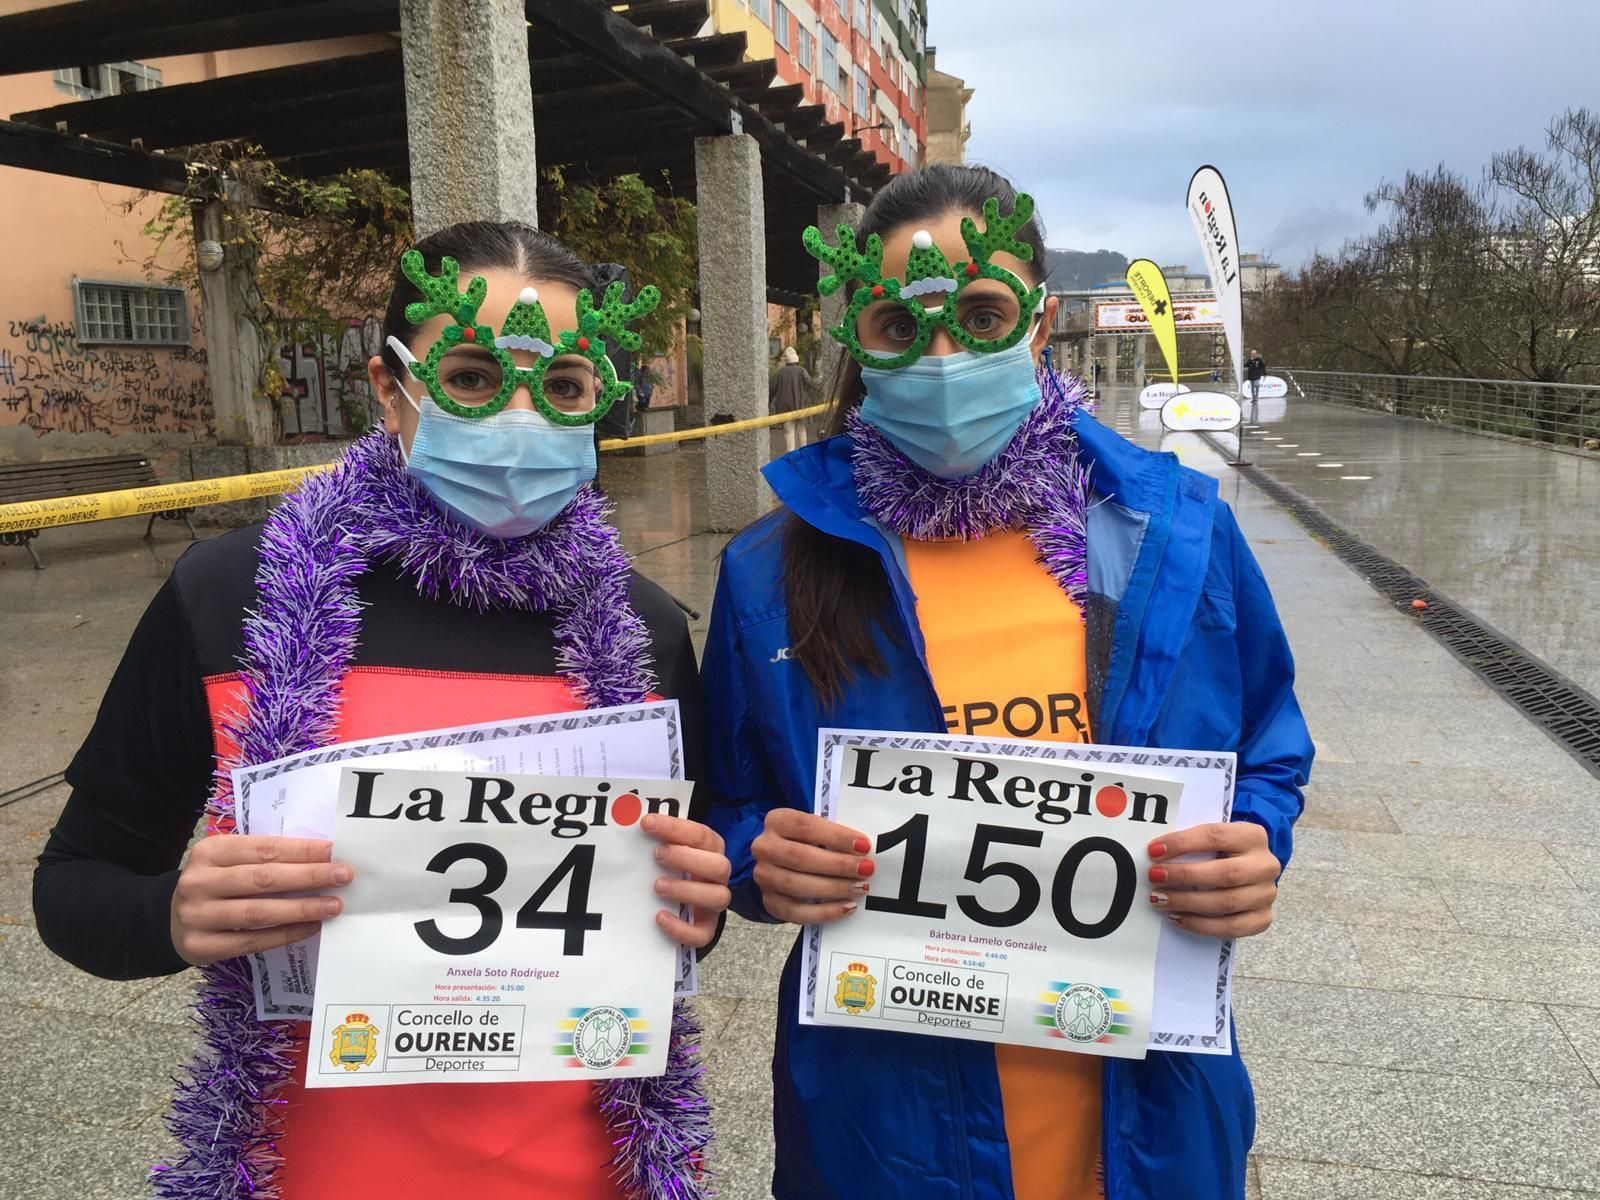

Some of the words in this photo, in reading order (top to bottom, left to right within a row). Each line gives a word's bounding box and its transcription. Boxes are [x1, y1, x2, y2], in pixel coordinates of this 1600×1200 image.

[137, 498, 176, 512] DEPORTES
[177, 497, 187, 506] DE
[188, 493, 221, 505] OURENSE
[43, 514, 57, 525] DE
[57, 509, 99, 523] OURENSE
[848, 748, 935, 797] La
[947, 757, 1169, 825] Región
[346, 771, 445, 822] La
[459, 776, 680, 839] Región
[864, 813, 1137, 939] 150
[414, 842, 603, 956] 34
[929, 929, 966, 942] Bárbara
[968, 934, 1003, 946] Lamelo
[1004, 939, 1048, 952] González
[924, 954, 940, 962] Hora
[940, 956, 960, 965] salida:
[963, 959, 985, 967] 4:54:40
[925, 944, 940, 952] Hora
[941, 946, 982, 957] presentación:
[985, 951, 1008, 960] 4:44:00
[447, 967, 482, 977] Anxela
[485, 967, 508, 978] Soto
[892, 965, 961, 987] Concello
[966, 974, 985, 990] de
[435, 984, 451, 992] Hora
[452, 984, 498, 993] presentación:
[500, 984, 525, 992] 4:25:00
[1065, 986, 1096, 998] MUNICIPAL
[1096, 992, 1104, 1002] DE
[890, 985, 1000, 1016] OURENSE
[397, 1010, 473, 1026] Concello
[479, 1010, 499, 1026] de
[584, 1008, 616, 1023] MUNICIPAL
[615, 1013, 624, 1024] DE
[918, 1012, 972, 1029] Deportes
[1056, 997, 1066, 1031] CONSELLO
[1096, 1002, 1110, 1036] DEPORTES
[394, 1032, 516, 1053] OURENSE
[574, 1022, 585, 1058] CONSELLO
[615, 1023, 629, 1058] DEPORTES
[425, 1057, 485, 1073] Deportes
